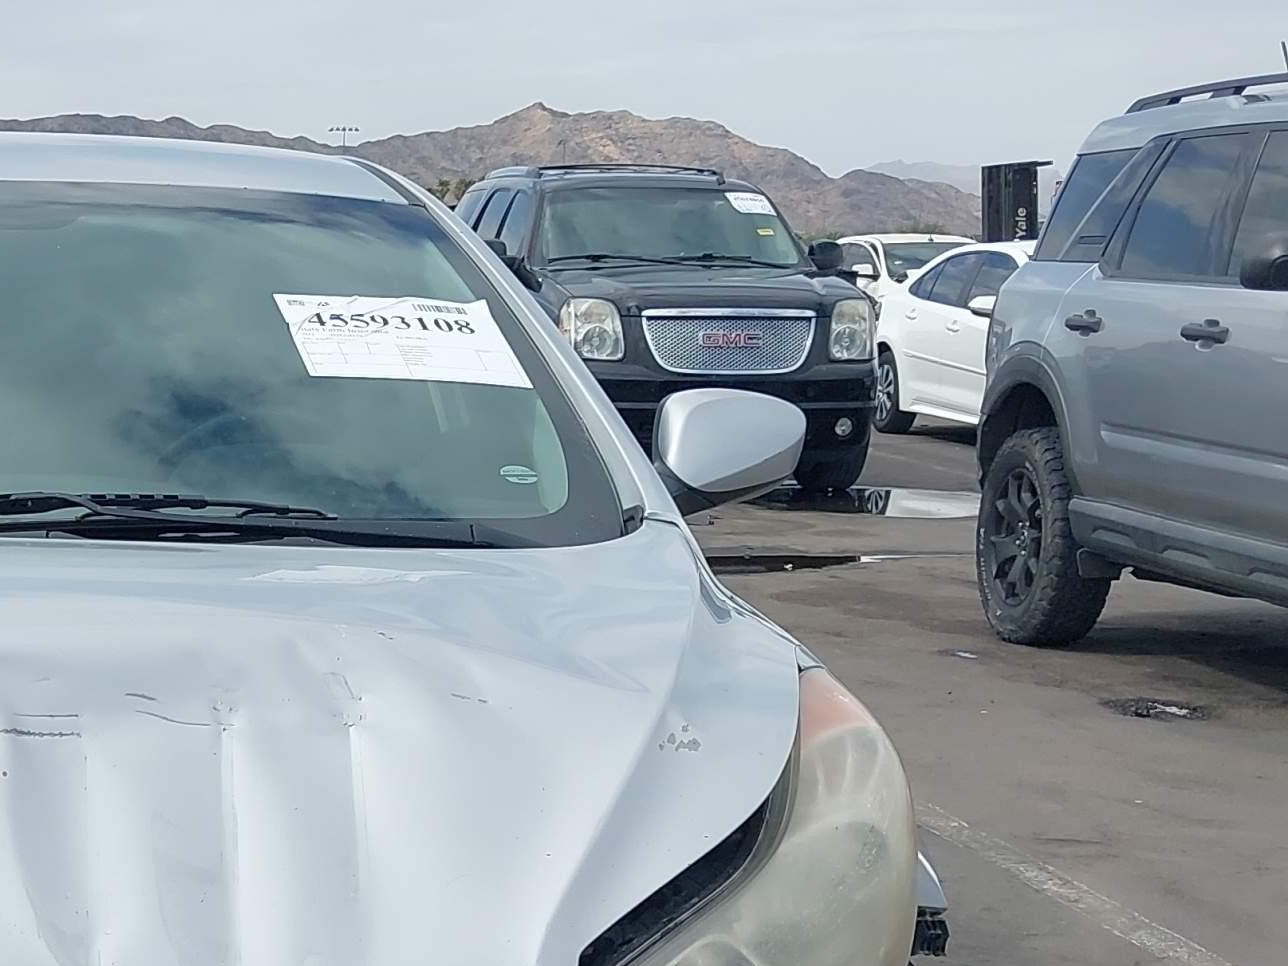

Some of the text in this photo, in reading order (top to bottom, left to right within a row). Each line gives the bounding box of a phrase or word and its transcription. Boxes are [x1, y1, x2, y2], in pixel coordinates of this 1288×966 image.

[1015, 207, 1027, 238] Yale
[308, 312, 476, 335] 45593108
[700, 332, 763, 348] GMC
